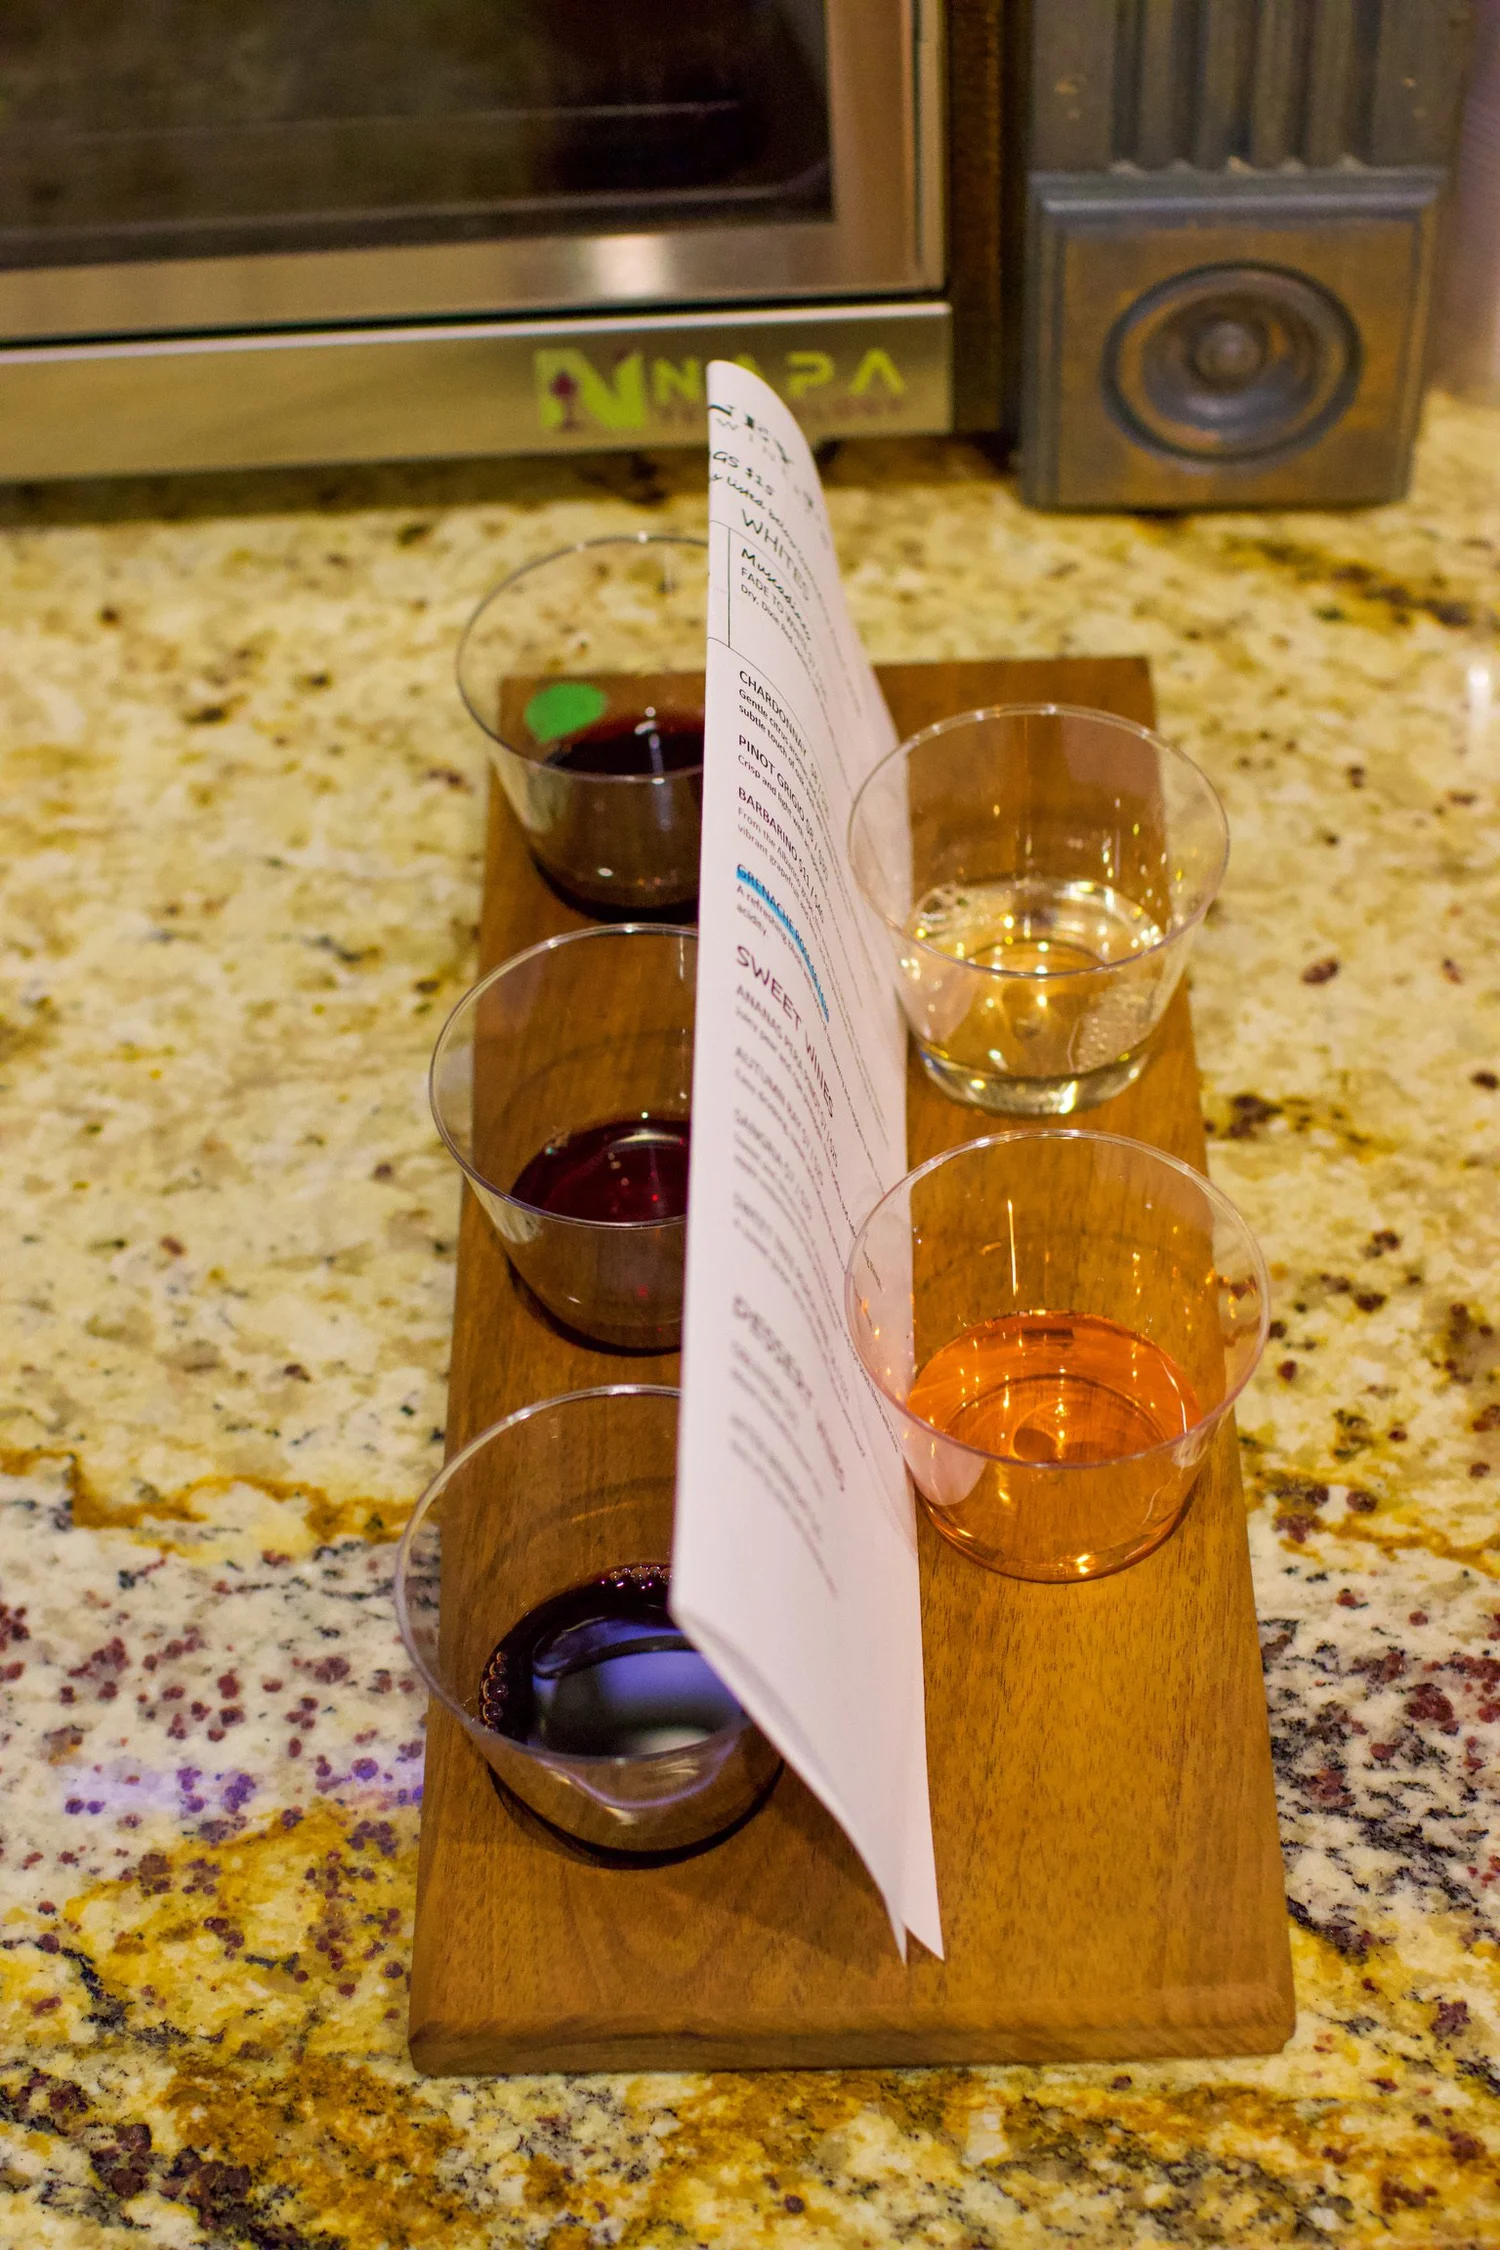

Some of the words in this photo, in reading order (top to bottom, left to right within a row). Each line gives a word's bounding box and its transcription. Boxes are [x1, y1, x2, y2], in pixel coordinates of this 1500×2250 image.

[738, 688, 769, 719] Gentle
[738, 670, 807, 757] CHARDONNAY
[738, 704, 767, 733] subtle
[767, 729, 788, 758] touch
[737, 753, 761, 779] Crisp
[762, 775, 777, 797] and
[738, 734, 775, 775] PINOT
[776, 772, 806, 821] GRIGIO
[737, 806, 762, 834] From
[737, 824, 768, 858] vibrant
[736, 863, 795, 936] GRENACHE
[736, 944, 802, 1031] SWEET
[805, 1030, 834, 1118] WINES
